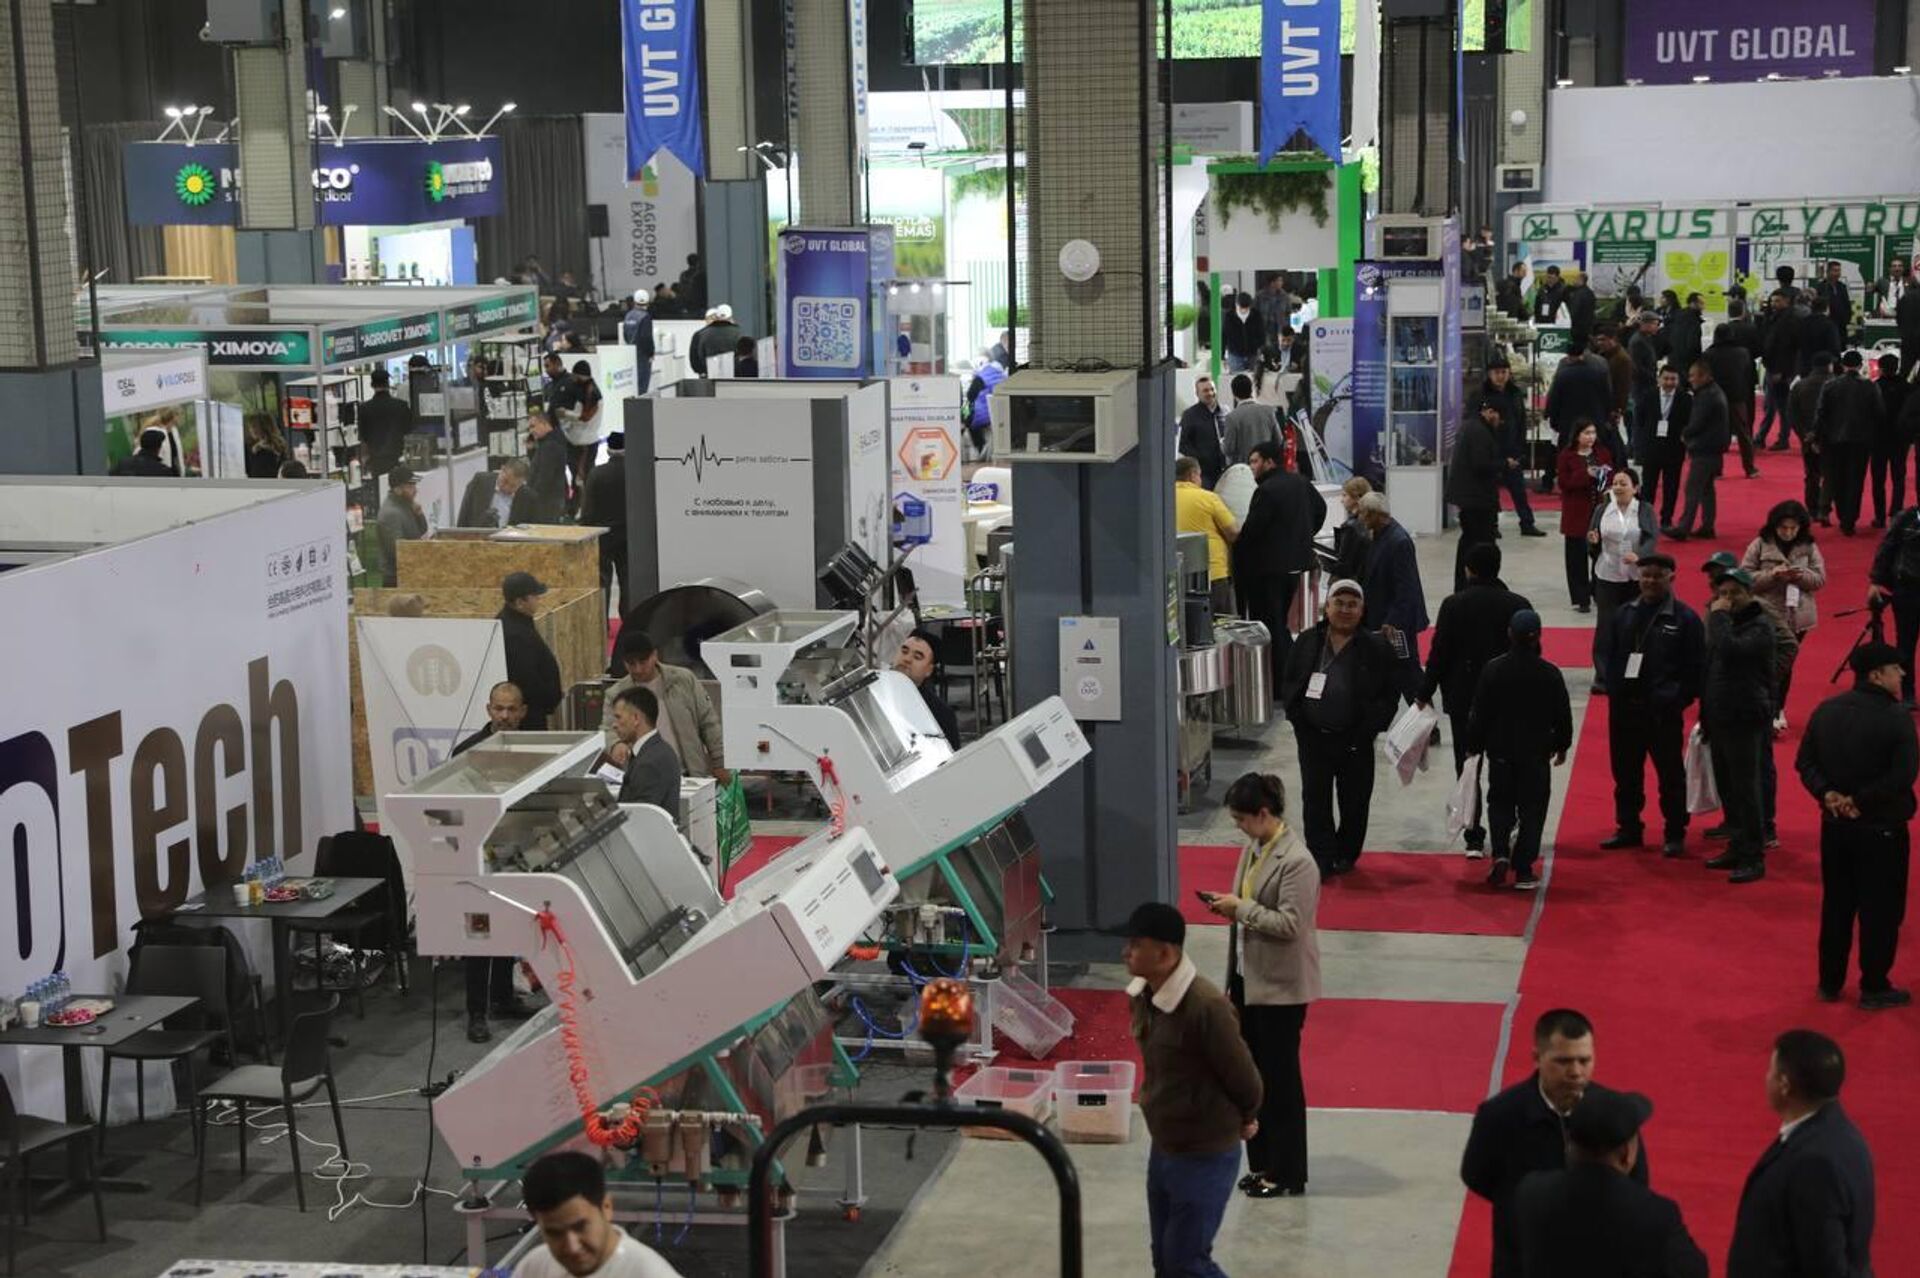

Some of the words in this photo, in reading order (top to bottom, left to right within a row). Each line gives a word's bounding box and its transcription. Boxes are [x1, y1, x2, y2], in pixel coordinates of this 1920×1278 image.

[1282, 20, 1320, 96] UVT
[1656, 30, 1718, 63] UVT
[1730, 24, 1855, 61] GLOBAL
[641, 44, 680, 117] UVT
[630, 201, 644, 239] EXPO
[896, 225, 932, 237] EMAS
[1574, 209, 1716, 240] YARUS
[644, 202, 658, 276] AGROPRO
[808, 239, 831, 251] UVT
[830, 239, 867, 252] GLOBAL
[631, 243, 645, 276] 2026
[212, 341, 296, 356] XIMOYA"
